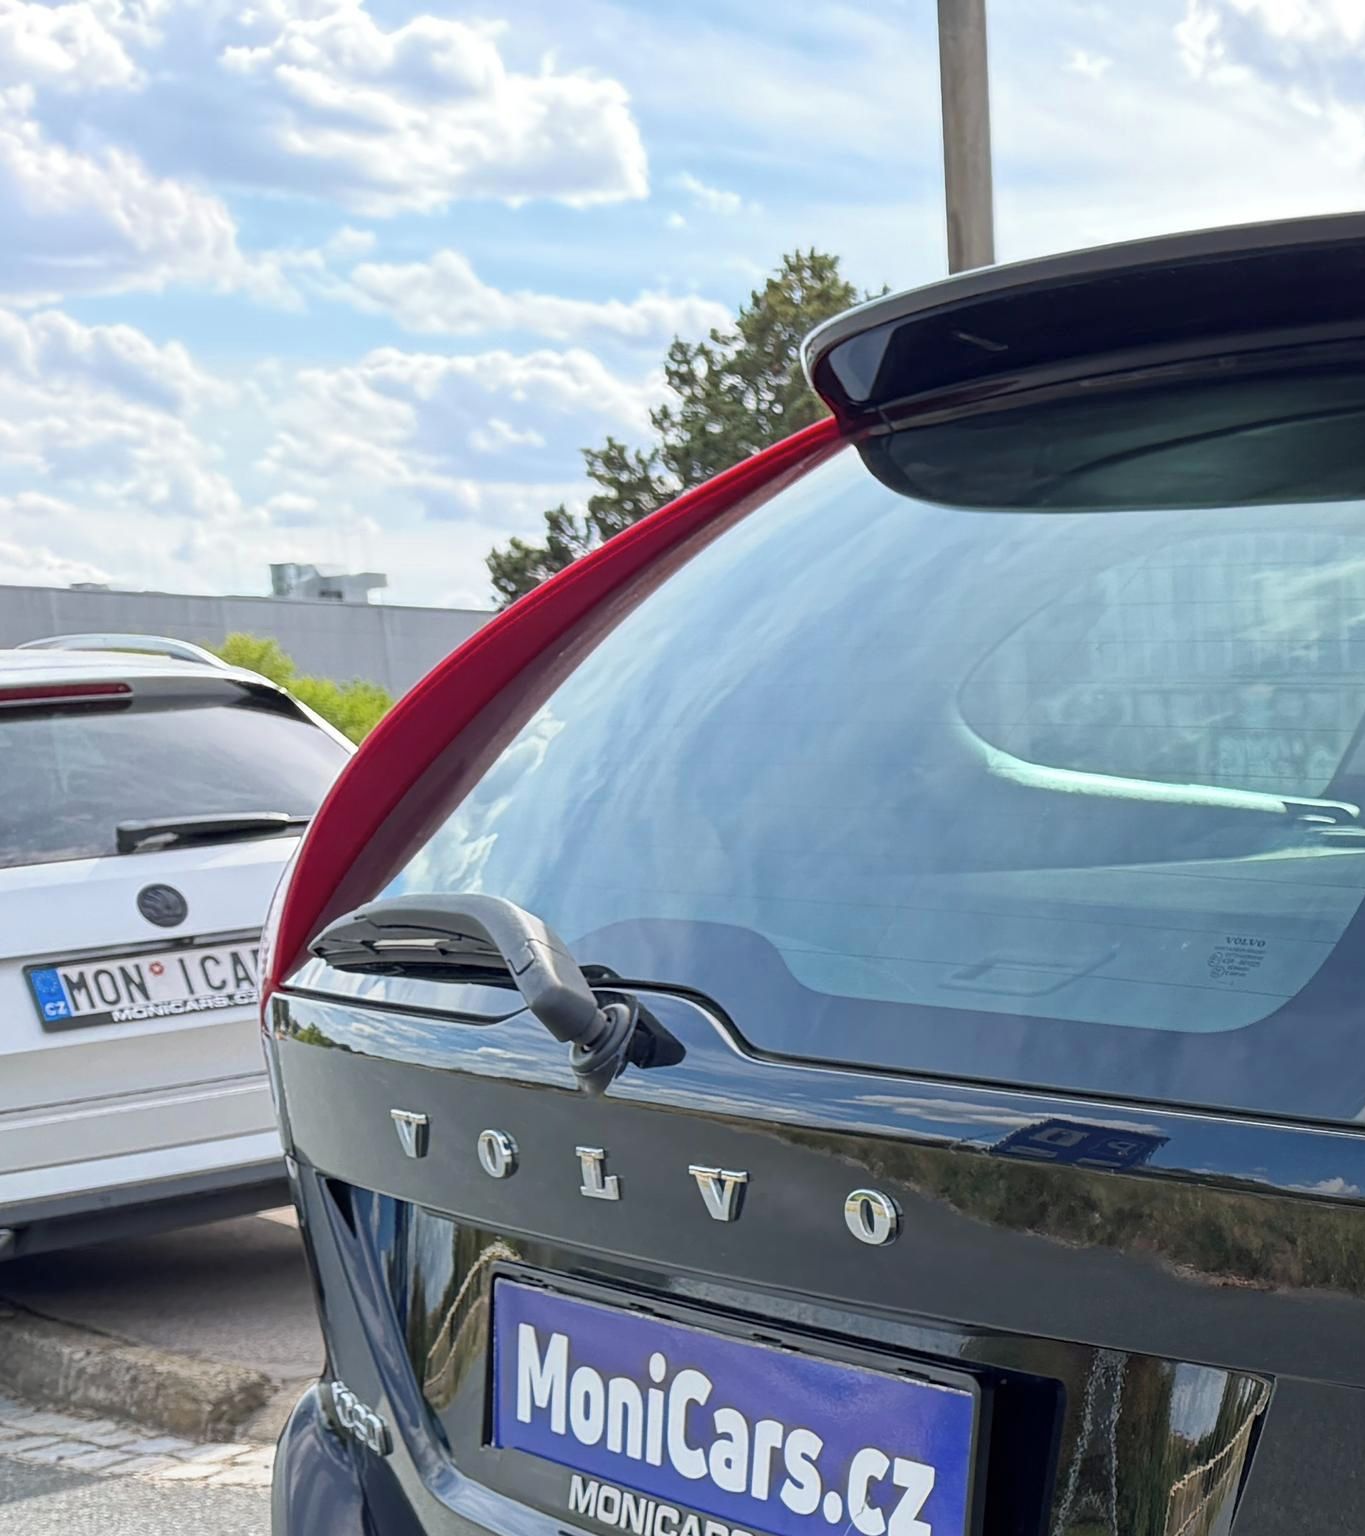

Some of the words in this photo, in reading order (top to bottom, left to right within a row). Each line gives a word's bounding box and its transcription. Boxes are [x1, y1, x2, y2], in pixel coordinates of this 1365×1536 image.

[44, 1001, 68, 1017] CZ
[62, 964, 150, 1013] MON
[390, 1109, 901, 1246] VOLVO
